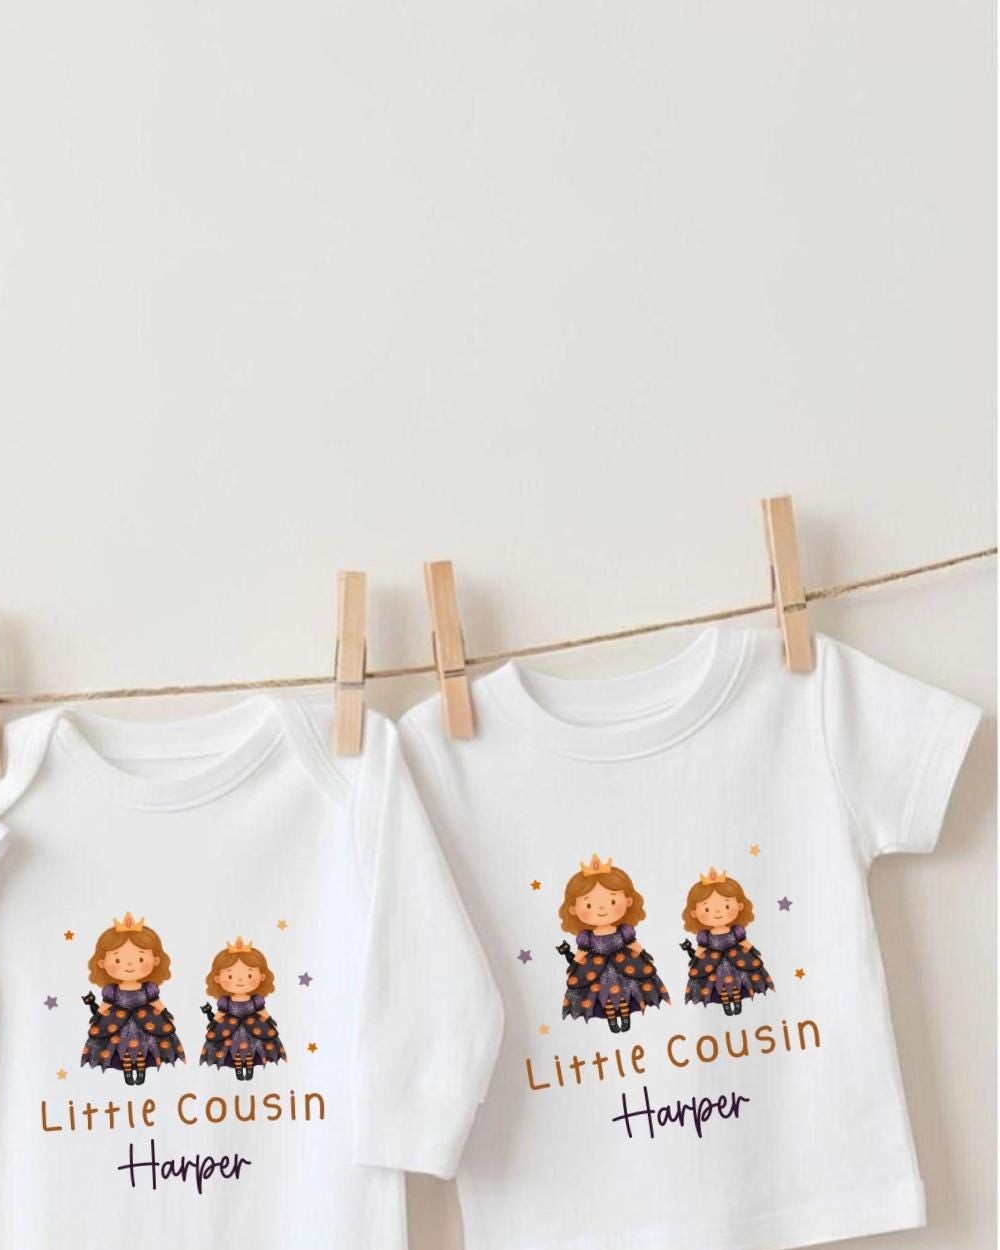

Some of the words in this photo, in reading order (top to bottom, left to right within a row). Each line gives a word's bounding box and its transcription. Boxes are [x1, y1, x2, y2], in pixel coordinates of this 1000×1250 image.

[525, 1044, 645, 1091] Little
[667, 1020, 822, 1069] Cousin
[41, 1099, 156, 1132] Little
[177, 1092, 326, 1125] Cousin
[612, 1086, 750, 1139] Harper
[117, 1138, 252, 1195] Harper
